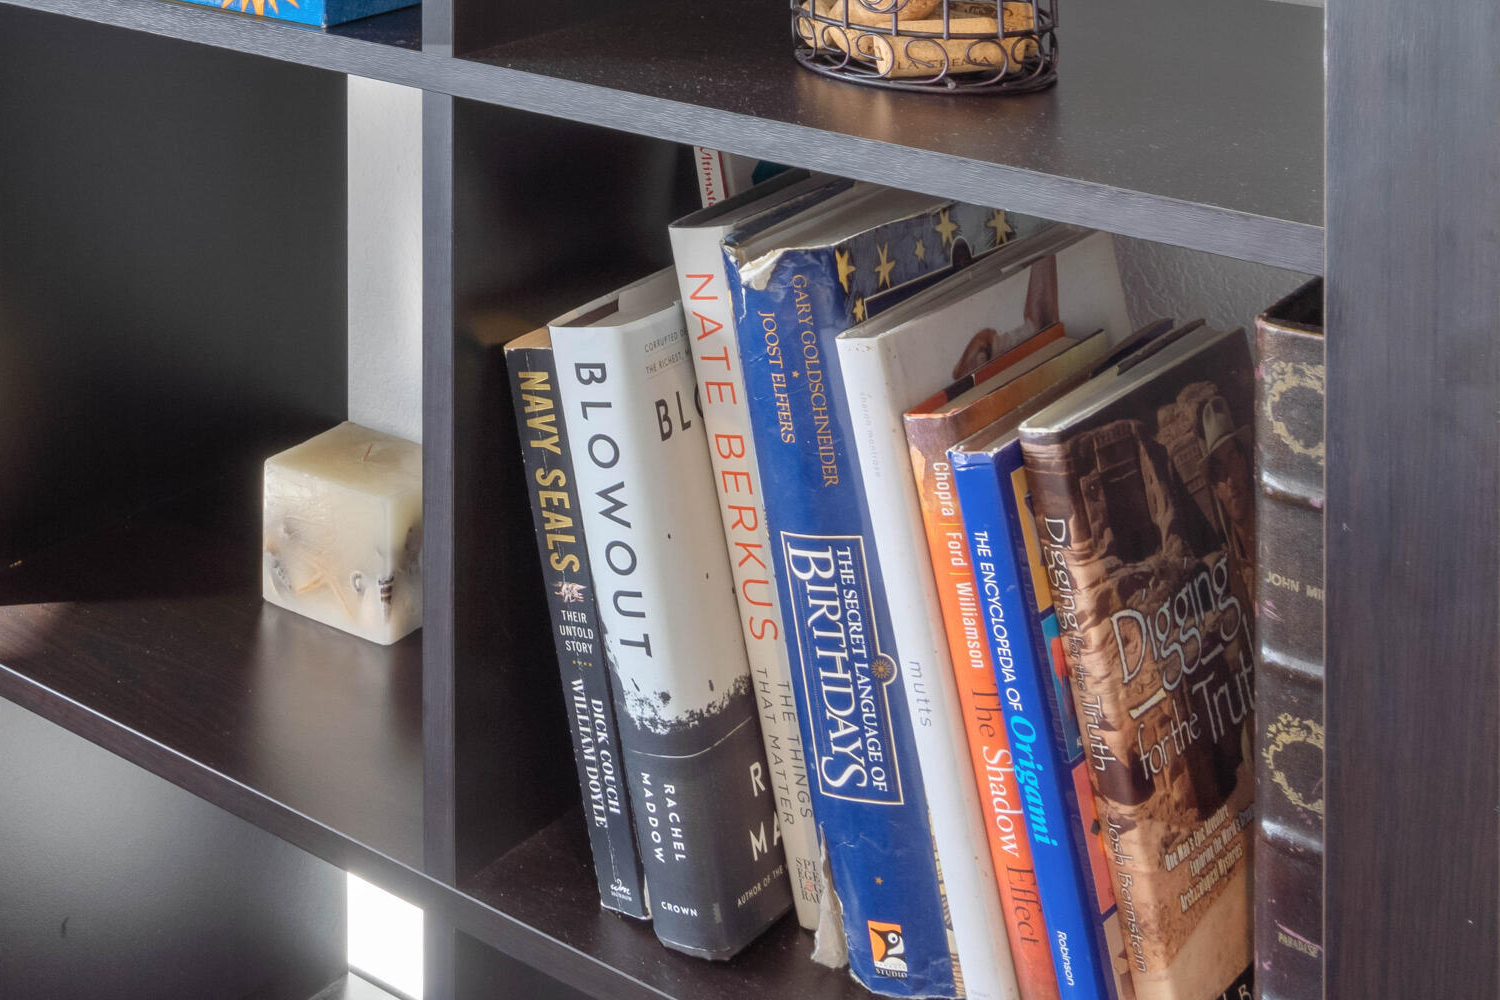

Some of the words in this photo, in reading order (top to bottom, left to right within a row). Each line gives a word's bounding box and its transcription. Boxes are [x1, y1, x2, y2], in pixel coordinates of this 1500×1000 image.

[685, 273, 738, 405] NATE
[791, 273, 814, 327] GARY
[645, 363, 657, 375] THE
[757, 310, 784, 369] JOOST
[771, 372, 796, 445] ELFFERS
[517, 371, 562, 455] NAVY
[800, 330, 839, 488] GOLDSCHNEIDER
[535, 467, 581, 573] SEALS
[574, 362, 653, 658] BLOWOUT
[933, 461, 955, 517] Chopra
[714, 433, 779, 641] BERKUS
[836, 546, 857, 586] THE
[945, 531, 968, 567] Ford
[974, 530, 992, 558] THE
[561, 610, 588, 624] THEIR
[1264, 570, 1300, 593] JOHN
[559, 624, 594, 640] UNTOLD
[565, 639, 593, 655] STORY
[840, 588, 869, 659] SECRET
[955, 581, 984, 668] Williamson
[979, 562, 1015, 683] ENCYCLOPEDIA
[1043, 517, 1078, 633] Digging
[1080, 695, 1118, 772] Truth
[1110, 552, 1241, 691] Digging
[786, 541, 868, 789] BIRTHDAYS
[907, 660, 932, 729] mutts
[1006, 686, 1023, 712] OF
[591, 699, 610, 745] DICK
[755, 667, 776, 725] THAT
[768, 734, 795, 826] MATTER
[777, 680, 797, 723] THE
[787, 734, 813, 819] THINGS
[855, 661, 884, 763] LANGUAGE
[971, 682, 1003, 738] The
[1137, 724, 1170, 780] for
[1170, 698, 1201, 757] the
[571, 679, 597, 766] WILLIAM
[586, 765, 609, 828] DOYLE
[600, 749, 621, 815] COUCH
[870, 766, 888, 793] OF
[1010, 714, 1058, 847] Origami
[640, 772, 666, 864] MADDOW
[663, 783, 687, 862] RACHEL
[983, 745, 1024, 859] Shadow
[1106, 814, 1133, 866] Josh
[660, 900, 698, 918] CROWN
[737, 882, 762, 908] AUTHOR
[763, 874, 771, 887] OF
[772, 864, 783, 879] THE
[1006, 863, 1043, 945] Effect
[1117, 872, 1148, 974] Bernstein
[875, 967, 908, 978] STUDIO
[1056, 930, 1076, 987] Robinson
